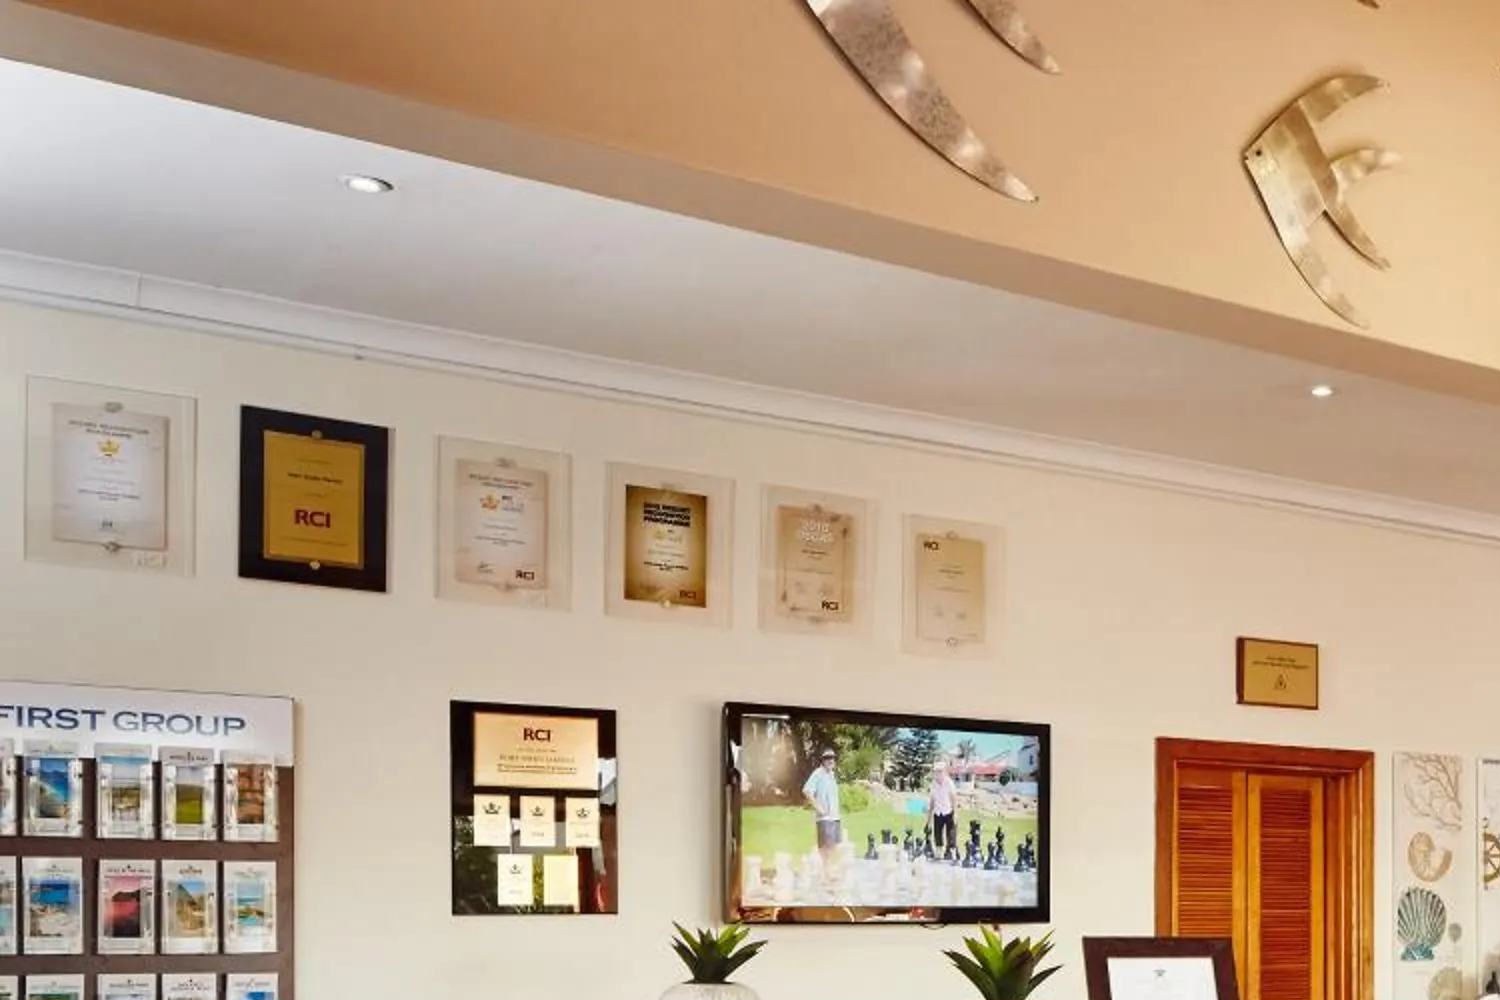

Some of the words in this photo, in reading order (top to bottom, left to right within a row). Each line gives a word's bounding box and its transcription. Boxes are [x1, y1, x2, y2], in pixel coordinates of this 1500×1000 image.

[295, 509, 331, 529] RCI
[821, 600, 839, 611] RCI
[113, 711, 246, 736] GROUP
[523, 728, 552, 742] RCI
